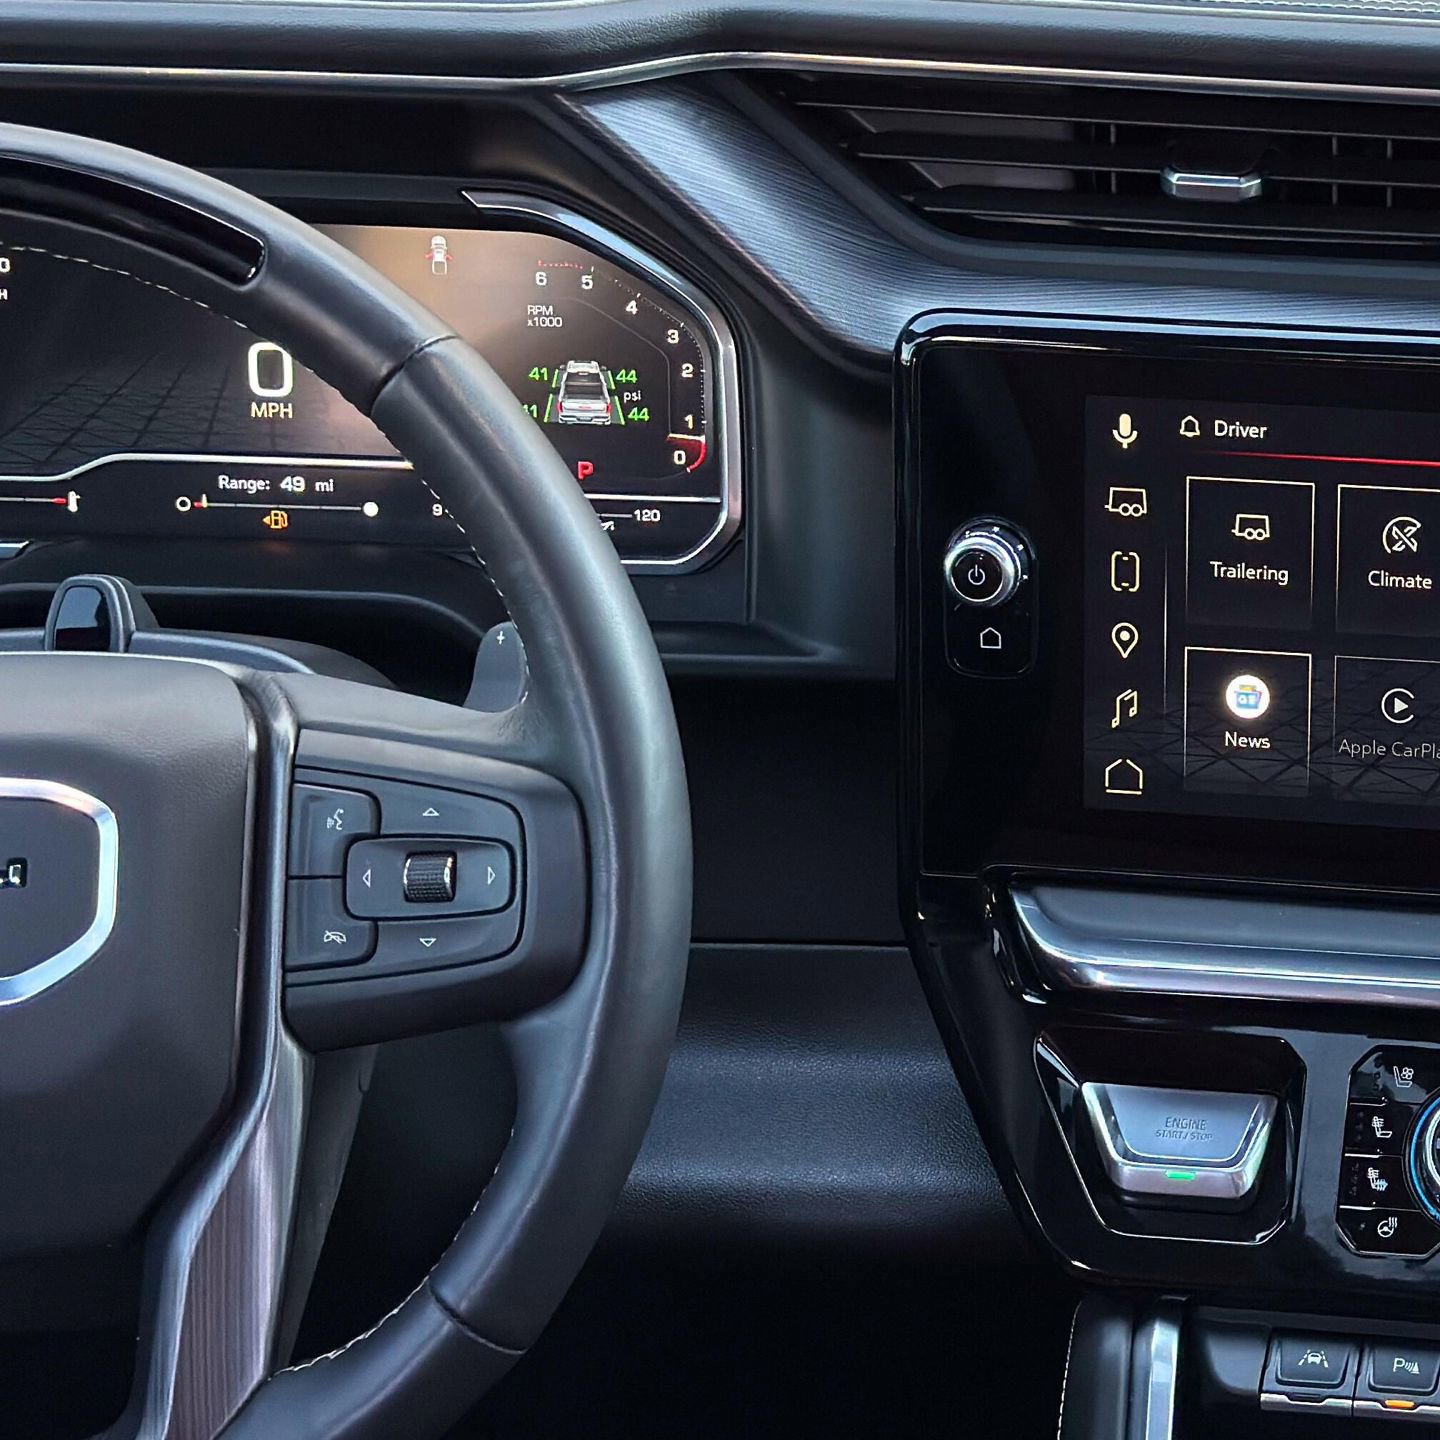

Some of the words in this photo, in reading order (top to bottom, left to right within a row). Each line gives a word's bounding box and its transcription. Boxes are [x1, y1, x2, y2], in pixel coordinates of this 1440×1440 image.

[535, 271, 547, 286] 6
[581, 275, 594, 290] 5
[527, 304, 554, 317] RPM
[625, 299, 638, 316] 4
[527, 317, 563, 328] x1000
[666, 328, 680, 345] 3
[247, 341, 294, 398] 0
[528, 366, 548, 382] 41
[615, 368, 638, 384] 44
[681, 362, 694, 378] 2
[623, 389, 642, 404] psi
[250, 402, 294, 419] MPH
[627, 406, 651, 423] 44
[683, 414, 694, 430] 1
[1213, 420, 1268, 441] Driver
[672, 449, 687, 466] 0
[577, 460, 595, 481] P
[217, 474, 272, 494] Range:
[279, 475, 307, 493] 49
[314, 477, 335, 494] mi
[431, 504, 444, 517] 9
[633, 508, 661, 524] 120
[1209, 560, 1290, 588] Trailering
[1367, 570, 1434, 592] Climate
[1223, 730, 1272, 751] News
[1338, 738, 1388, 762] Apple
[1165, 1116, 1208, 1131] ENGINE
